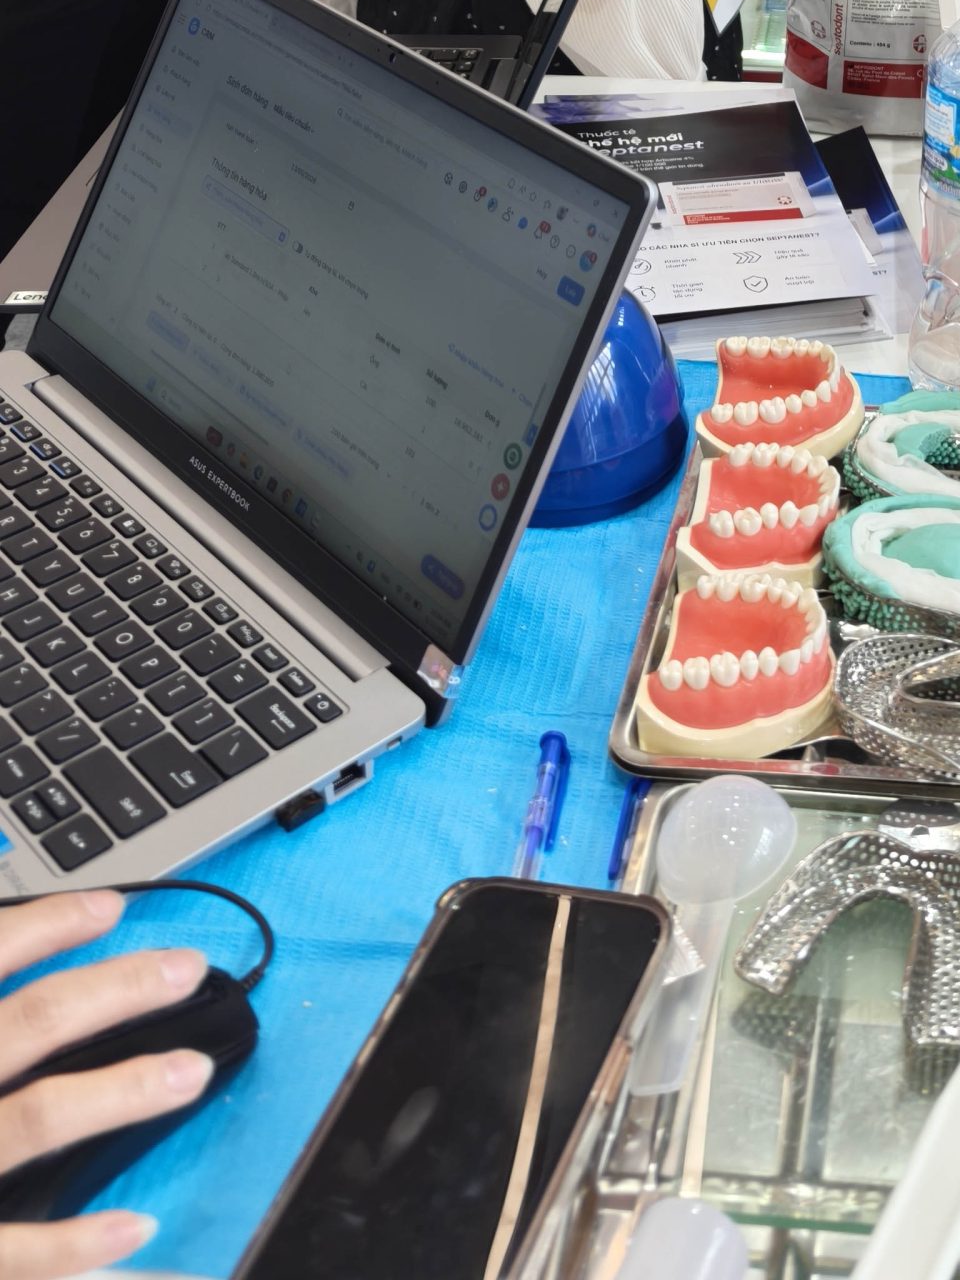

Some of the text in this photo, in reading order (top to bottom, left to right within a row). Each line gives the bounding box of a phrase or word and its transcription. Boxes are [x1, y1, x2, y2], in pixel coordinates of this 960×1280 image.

[834, 3, 844, 56] septodont
[224, 73, 241, 91] Sinh
[250, 89, 270, 111] hàng
[577, 129, 619, 138] Thuốc
[581, 132, 684, 148] hế hệ mới
[598, 140, 705, 157] eptanest
[209, 156, 231, 179] Thông
[237, 174, 256, 196] hàng
[13, 466, 28, 475] 3
[189, 455, 250, 512] ASUS EXPERTBOOK
[36, 487, 49, 496] 4
[57, 507, 72, 517] 5
[80, 529, 94, 538] 6
[22, 538, 38, 548] T
[102, 550, 119, 558] 7
[45, 560, 61, 570] Y
[127, 574, 142, 584] 8
[0, 588, 19, 600] H
[66, 583, 85, 596] U
[153, 597, 167, 606] 9
[24, 616, 41, 624] J
[47, 637, 66, 650] K
[141, 658, 159, 668] P
[72, 663, 88, 676] L
